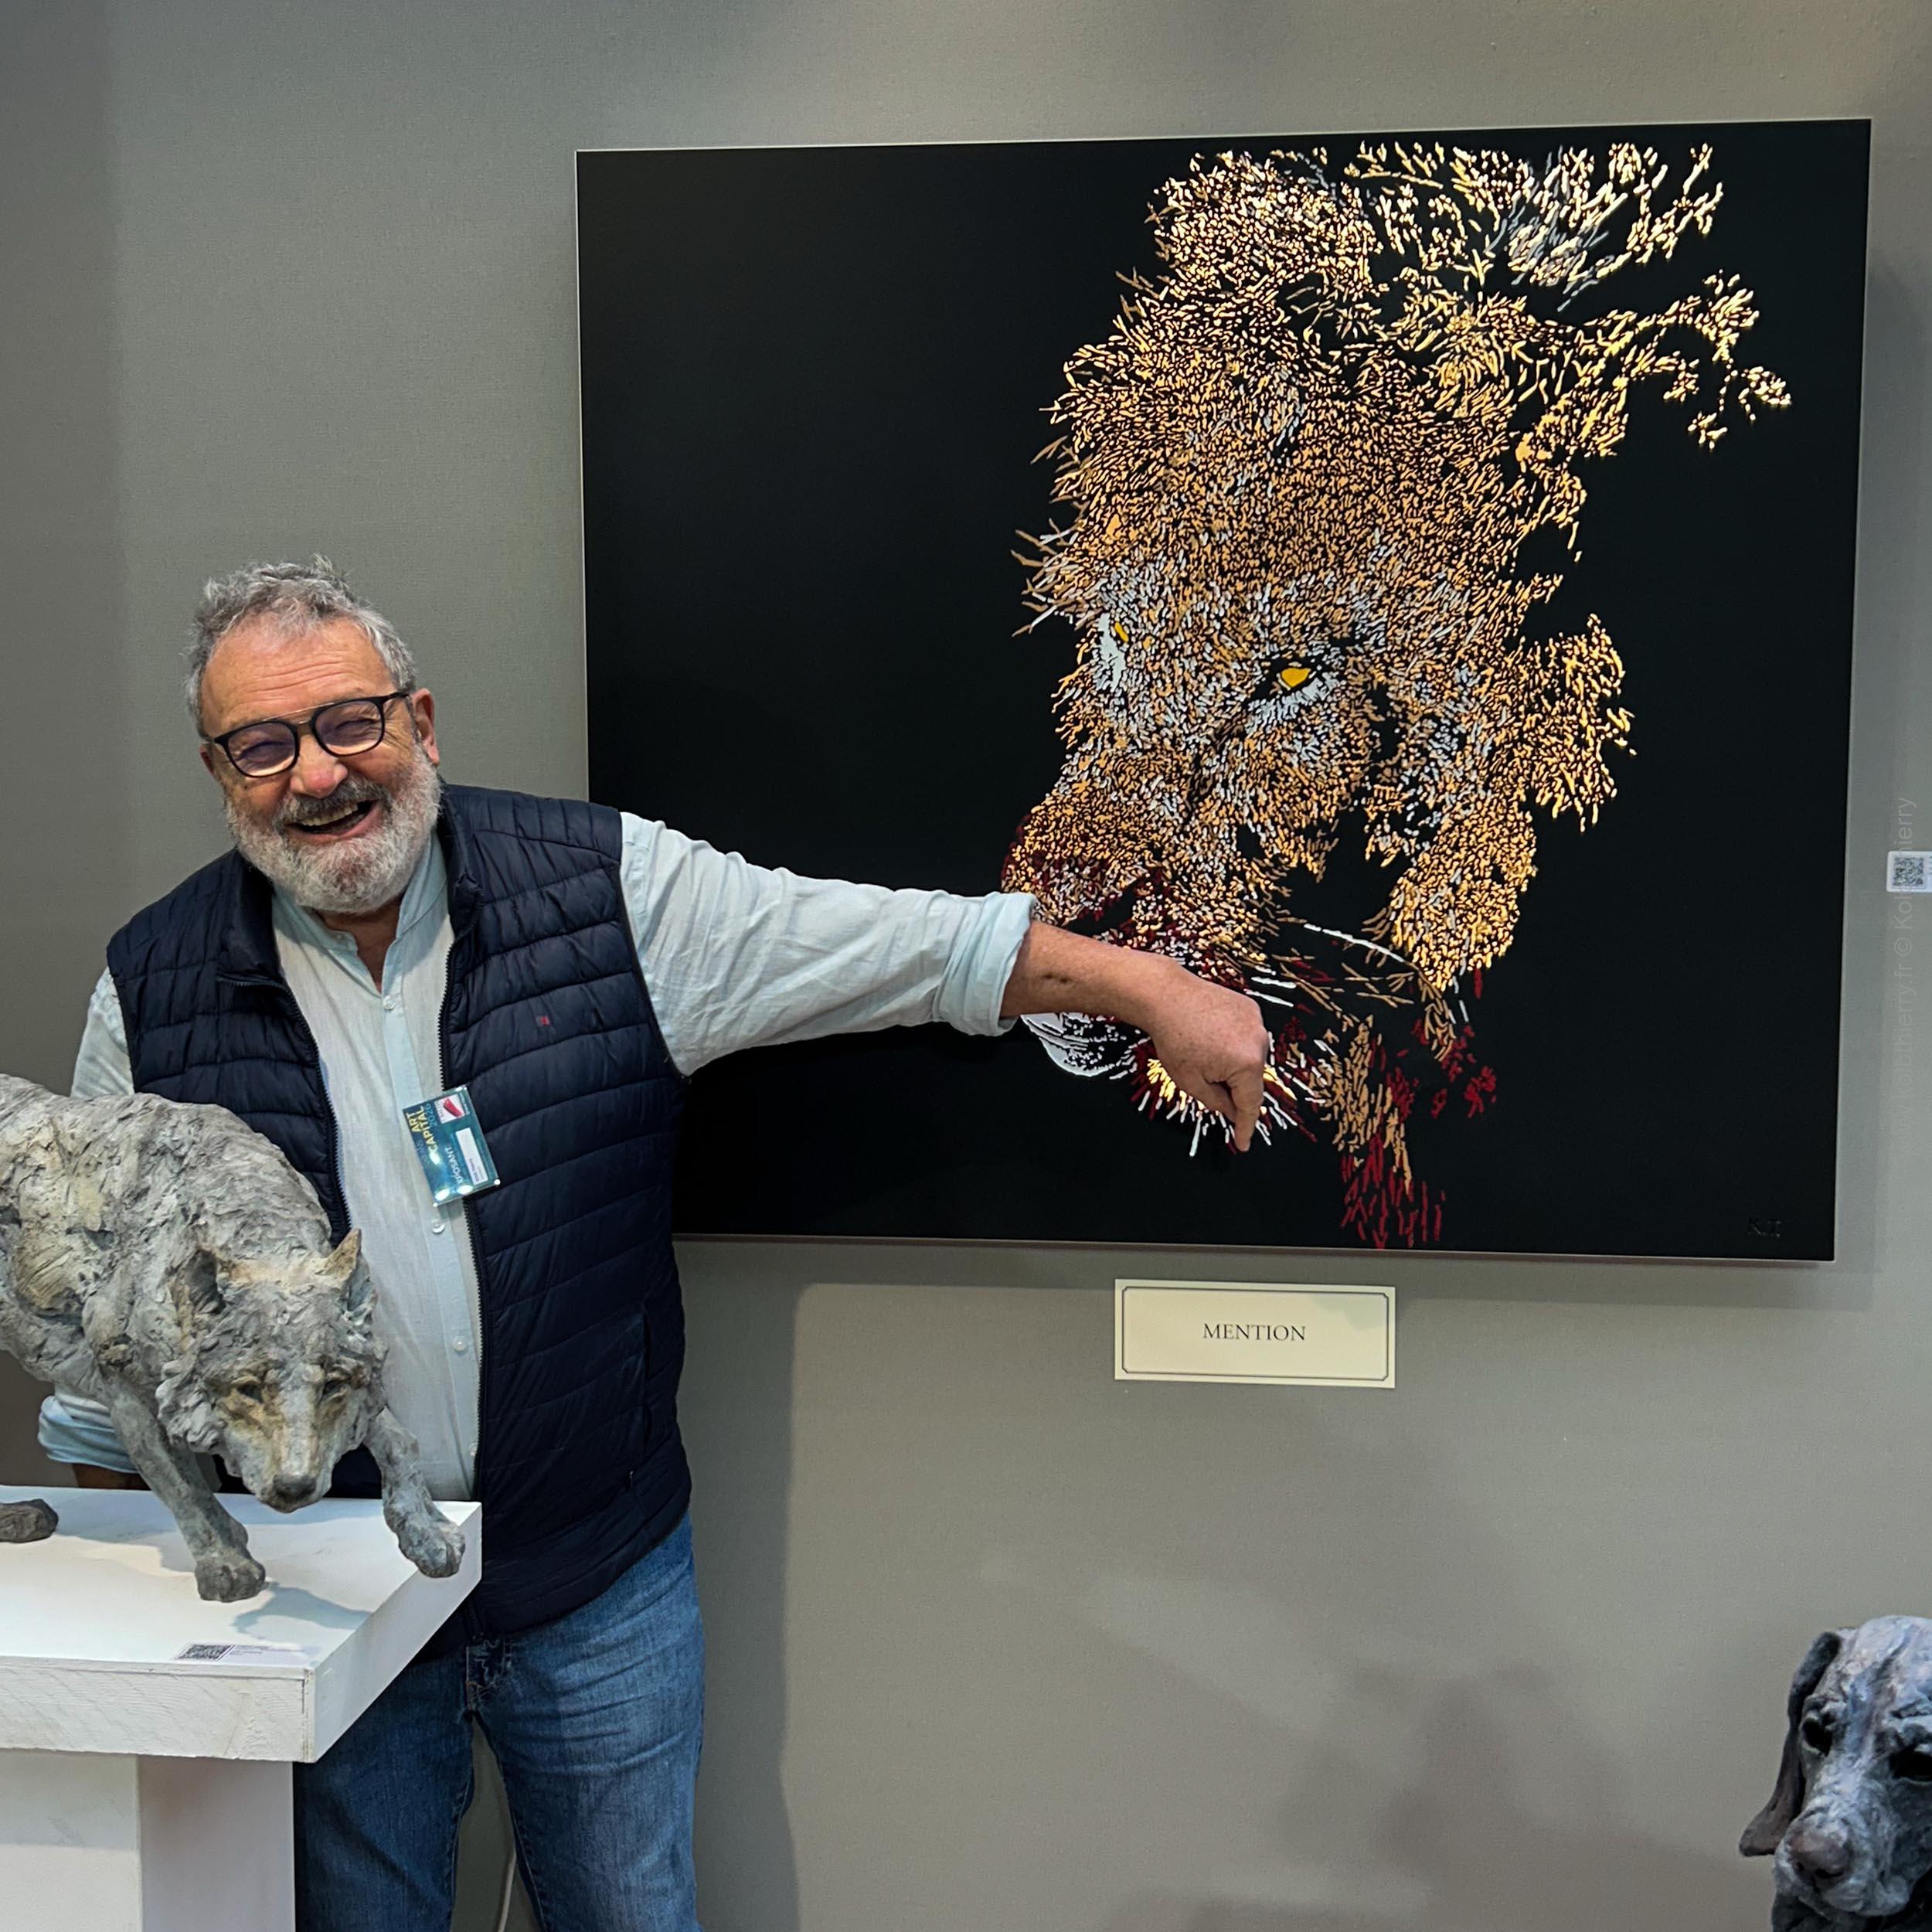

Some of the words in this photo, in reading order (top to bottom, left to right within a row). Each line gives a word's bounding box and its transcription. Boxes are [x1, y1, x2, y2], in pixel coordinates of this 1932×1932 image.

[406, 1111, 422, 1133] ART
[425, 1102, 438, 1128] 2026
[416, 1105, 439, 1154] CAPITAL
[446, 1146, 464, 1191] XPOSANT
[1203, 1323, 1305, 1341] MENTION
